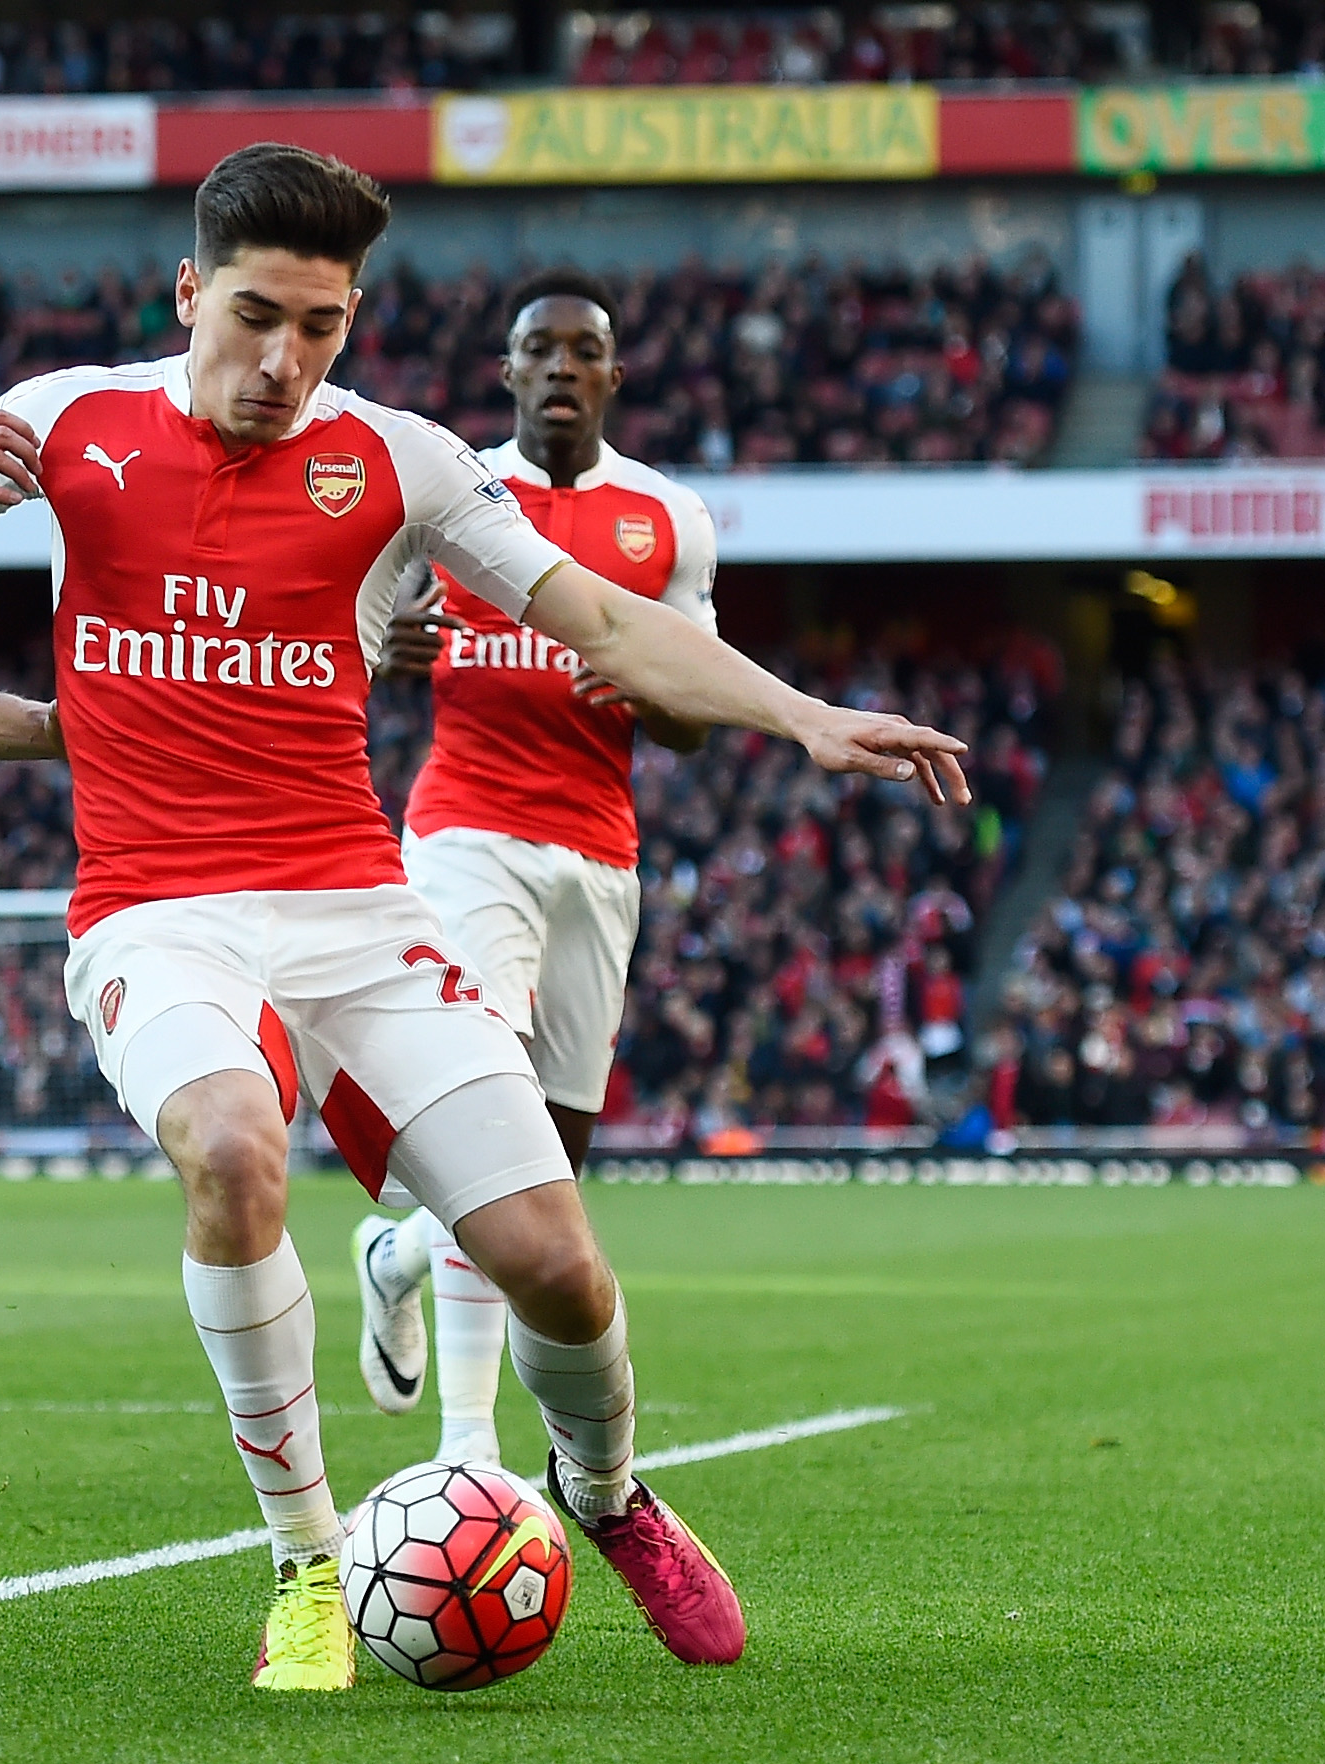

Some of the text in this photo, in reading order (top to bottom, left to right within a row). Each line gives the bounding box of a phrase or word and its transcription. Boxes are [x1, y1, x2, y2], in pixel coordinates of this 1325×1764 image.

[521, 93, 928, 168] AUSTRALIA
[1091, 88, 1309, 167] OVER
[312, 462, 357, 473] Arsenal
[163, 574, 246, 628] Fly
[73, 614, 335, 687] Emirates
[449, 624, 591, 678] Emira
